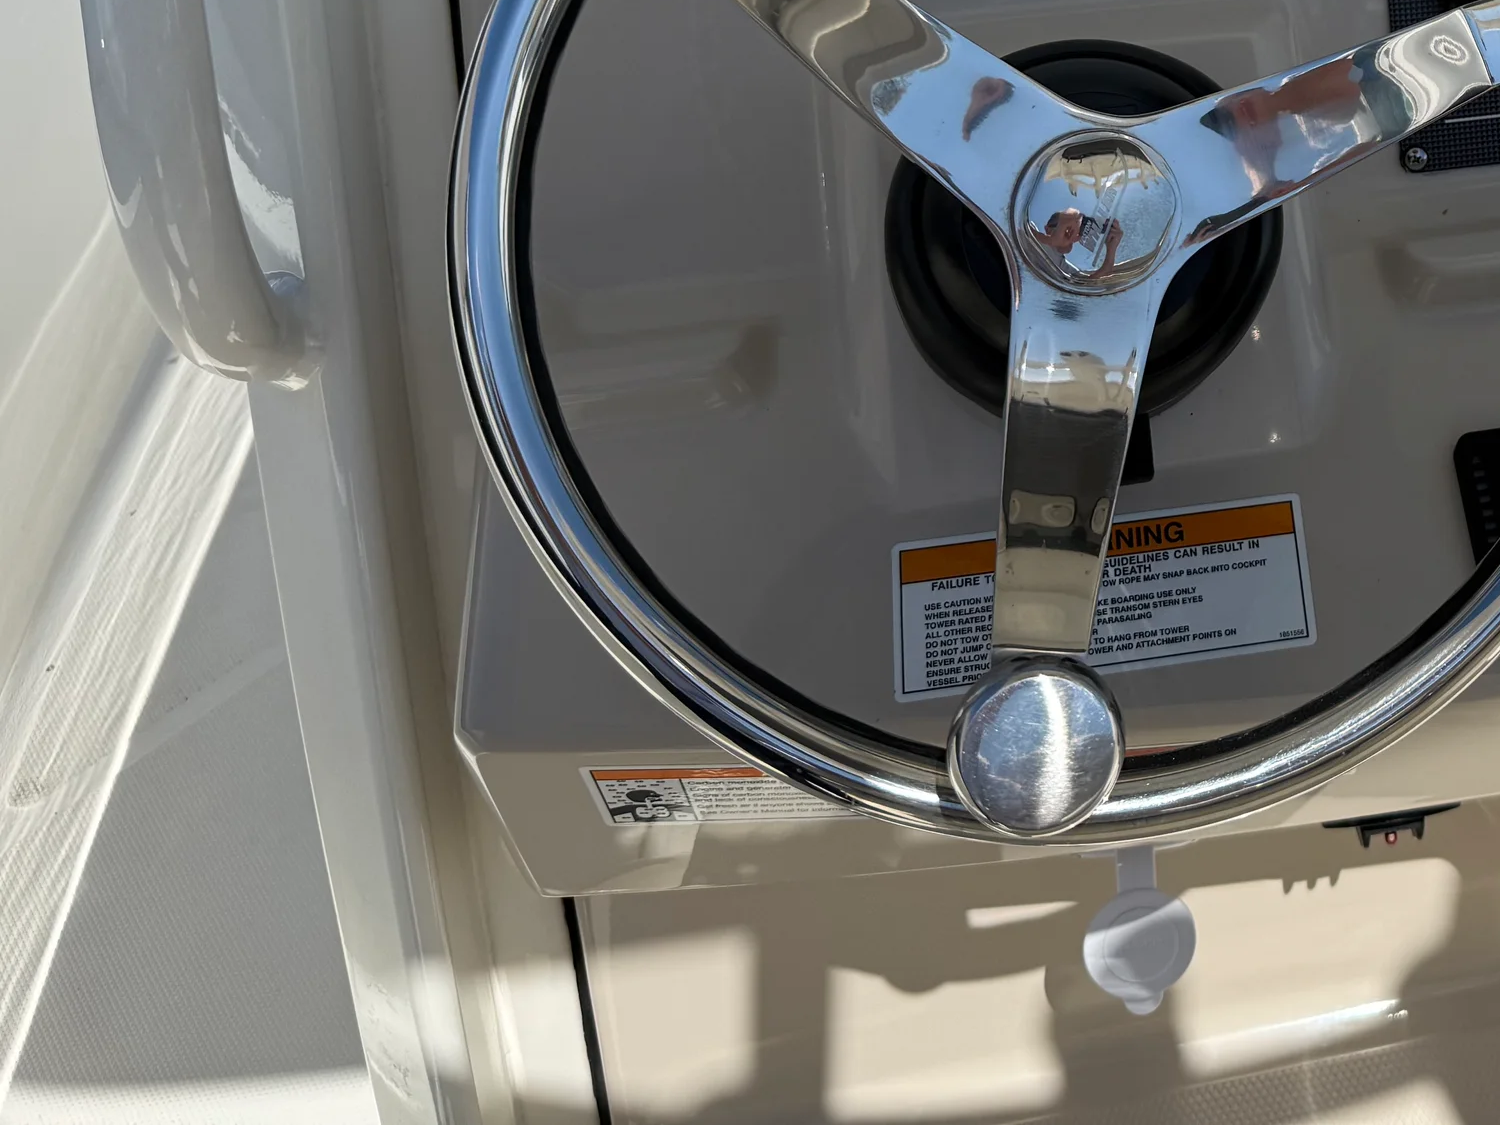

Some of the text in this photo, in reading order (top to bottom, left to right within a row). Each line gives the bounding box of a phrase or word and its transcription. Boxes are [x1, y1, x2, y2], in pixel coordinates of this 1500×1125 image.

[1108, 521, 1185, 550] NING
[924, 602, 942, 611] USE
[944, 597, 982, 609] CAUTION
[1119, 575, 1141, 585] ROPE
[1143, 572, 1161, 582] MAY
[1162, 569, 1185, 579] SNAP
[1187, 566, 1210, 576] BACK
[1211, 563, 1230, 573] INTO
[1231, 558, 1267, 570] COCKPIT
[931, 576, 981, 591] FAILURE
[1174, 547, 1198, 559] CAN
[1202, 541, 1244, 555] RESULT
[1248, 539, 1260, 549] IN
[1114, 564, 1152, 577] DEATH
[925, 620, 956, 630] TOWER
[958, 616, 987, 626] RATED
[1110, 592, 1155, 605] BOARDING
[1156, 590, 1174, 598] USE
[1175, 586, 1197, 596] ONLY
[925, 606, 993, 621] WHEN RELEASE
[925, 632, 942, 640] ALL
[943, 626, 973, 637] OTHER
[1110, 602, 1151, 615] TRANSOM
[1152, 598, 1180, 609] STERN
[1181, 595, 1204, 605] EYES
[925, 641, 939, 649] DO
[940, 637, 959, 648] NOT
[960, 635, 980, 645] TOW
[1097, 611, 1153, 626] PARASAILING
[926, 625, 1190, 668] NEVER ALLOW TO HANG FROM TOWER
[926, 650, 939, 659] DO
[940, 646, 959, 657] NOT
[960, 643, 984, 654] JUMP
[926, 667, 962, 678] ENSURE
[1115, 642, 1134, 652] AND
[1135, 634, 1191, 649] ATTACHMENT
[1192, 629, 1223, 641] POINTS
[1224, 628, 1237, 637] ON
[927, 676, 961, 687] VESSEL
